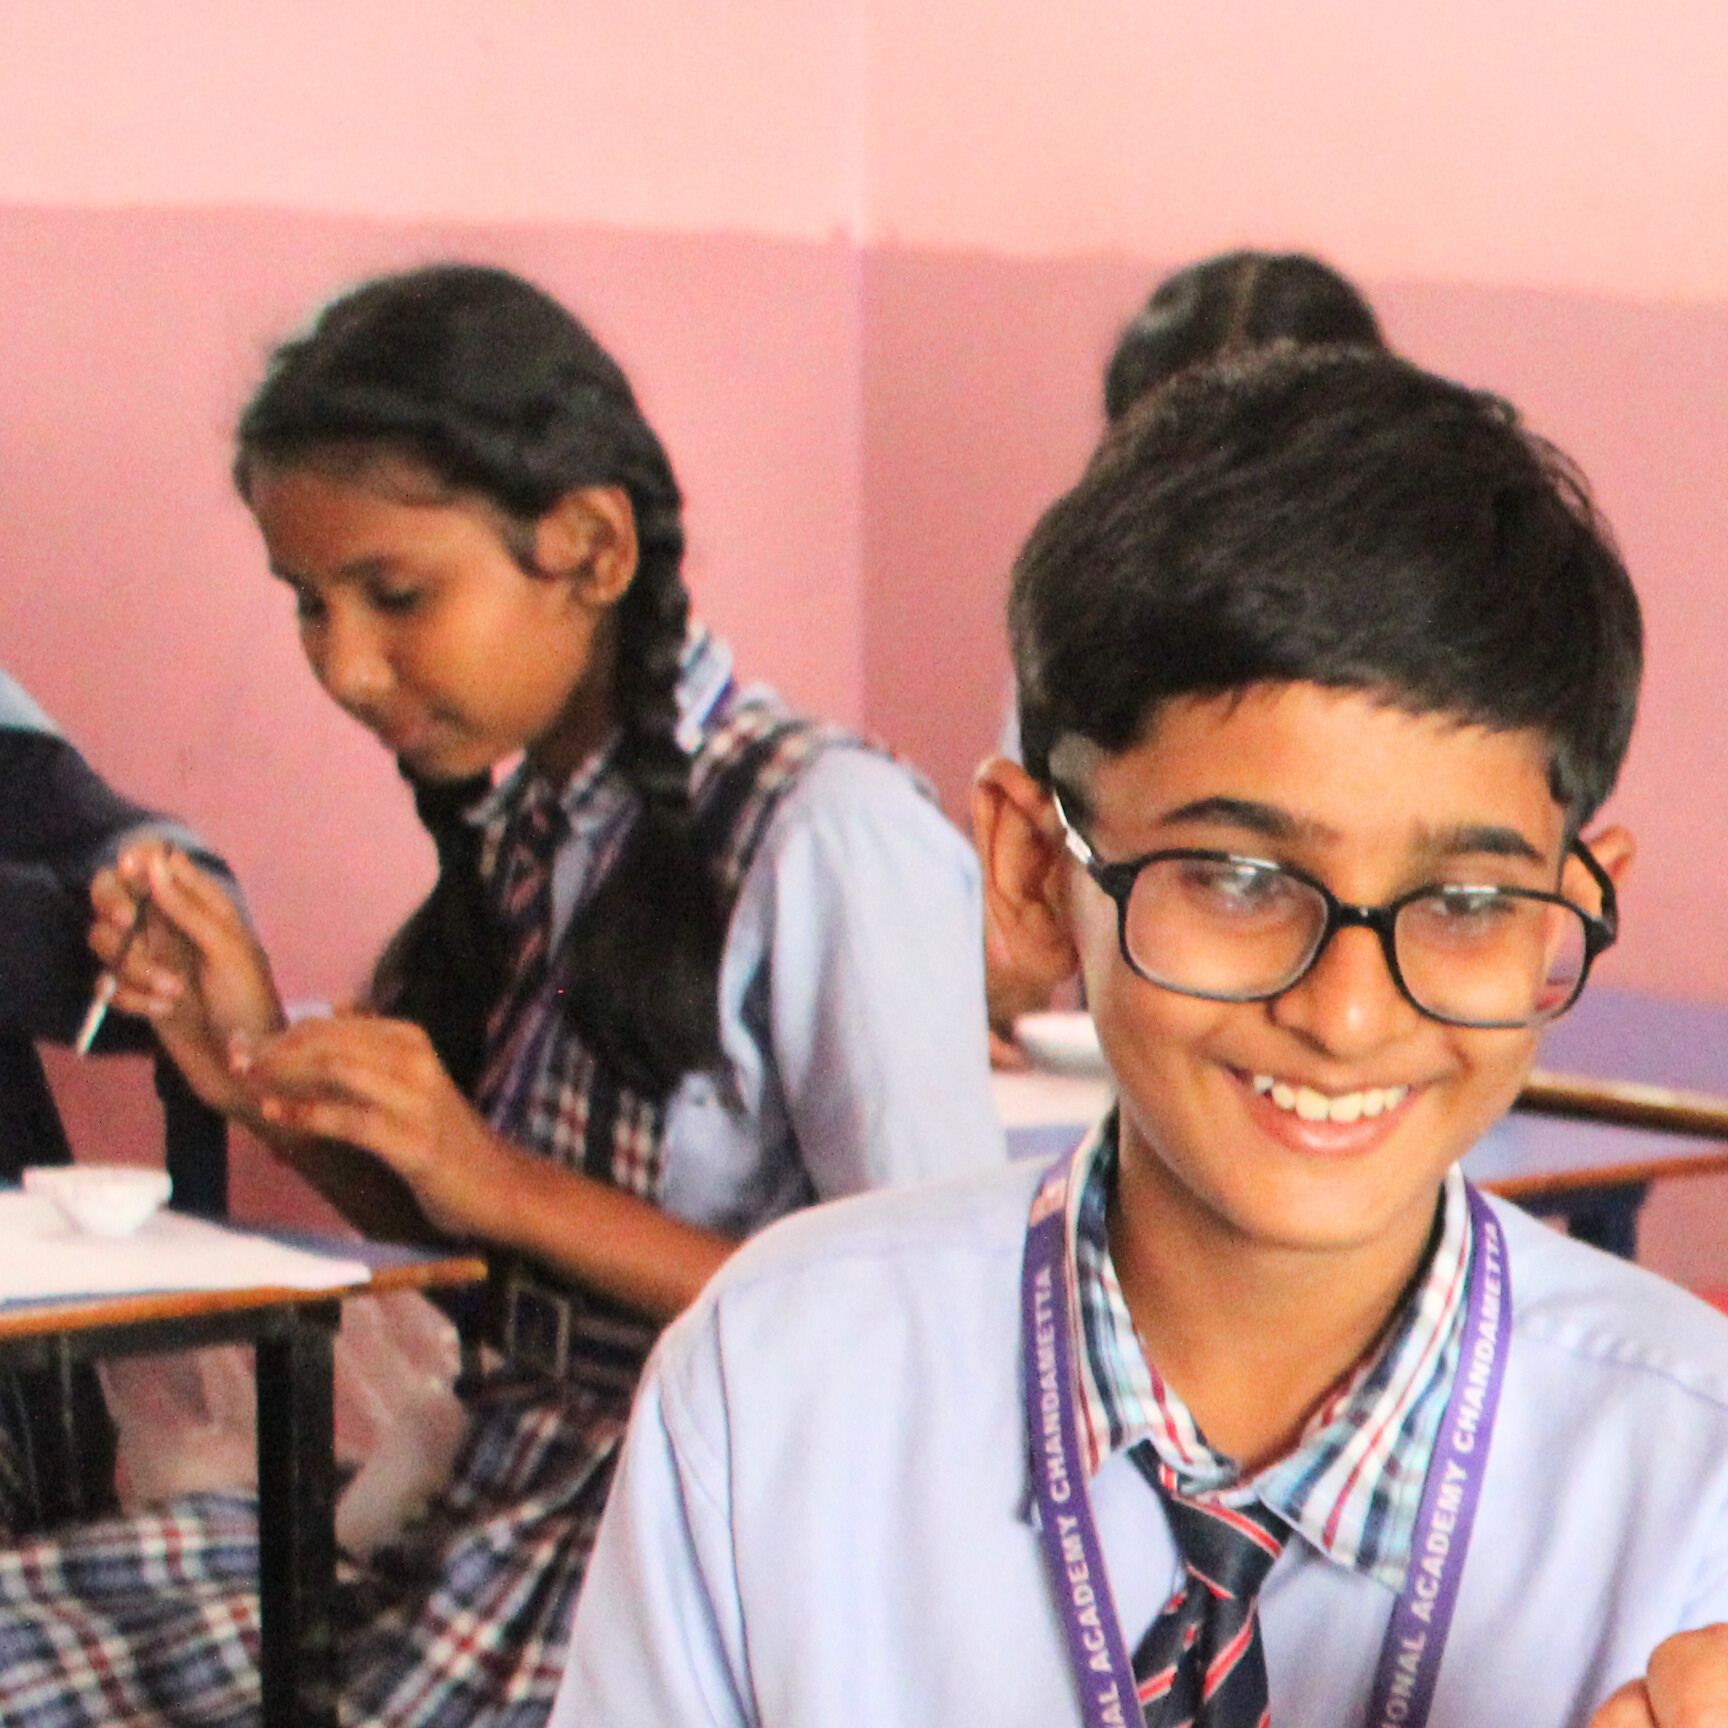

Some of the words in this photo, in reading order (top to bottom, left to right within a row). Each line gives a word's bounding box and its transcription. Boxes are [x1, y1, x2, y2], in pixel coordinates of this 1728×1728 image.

[1411, 1458, 1468, 1624] ACADEMY
[1452, 1220, 1502, 1454] CHANDAMETTA
[1056, 1514, 1114, 1674] ACADEMY
